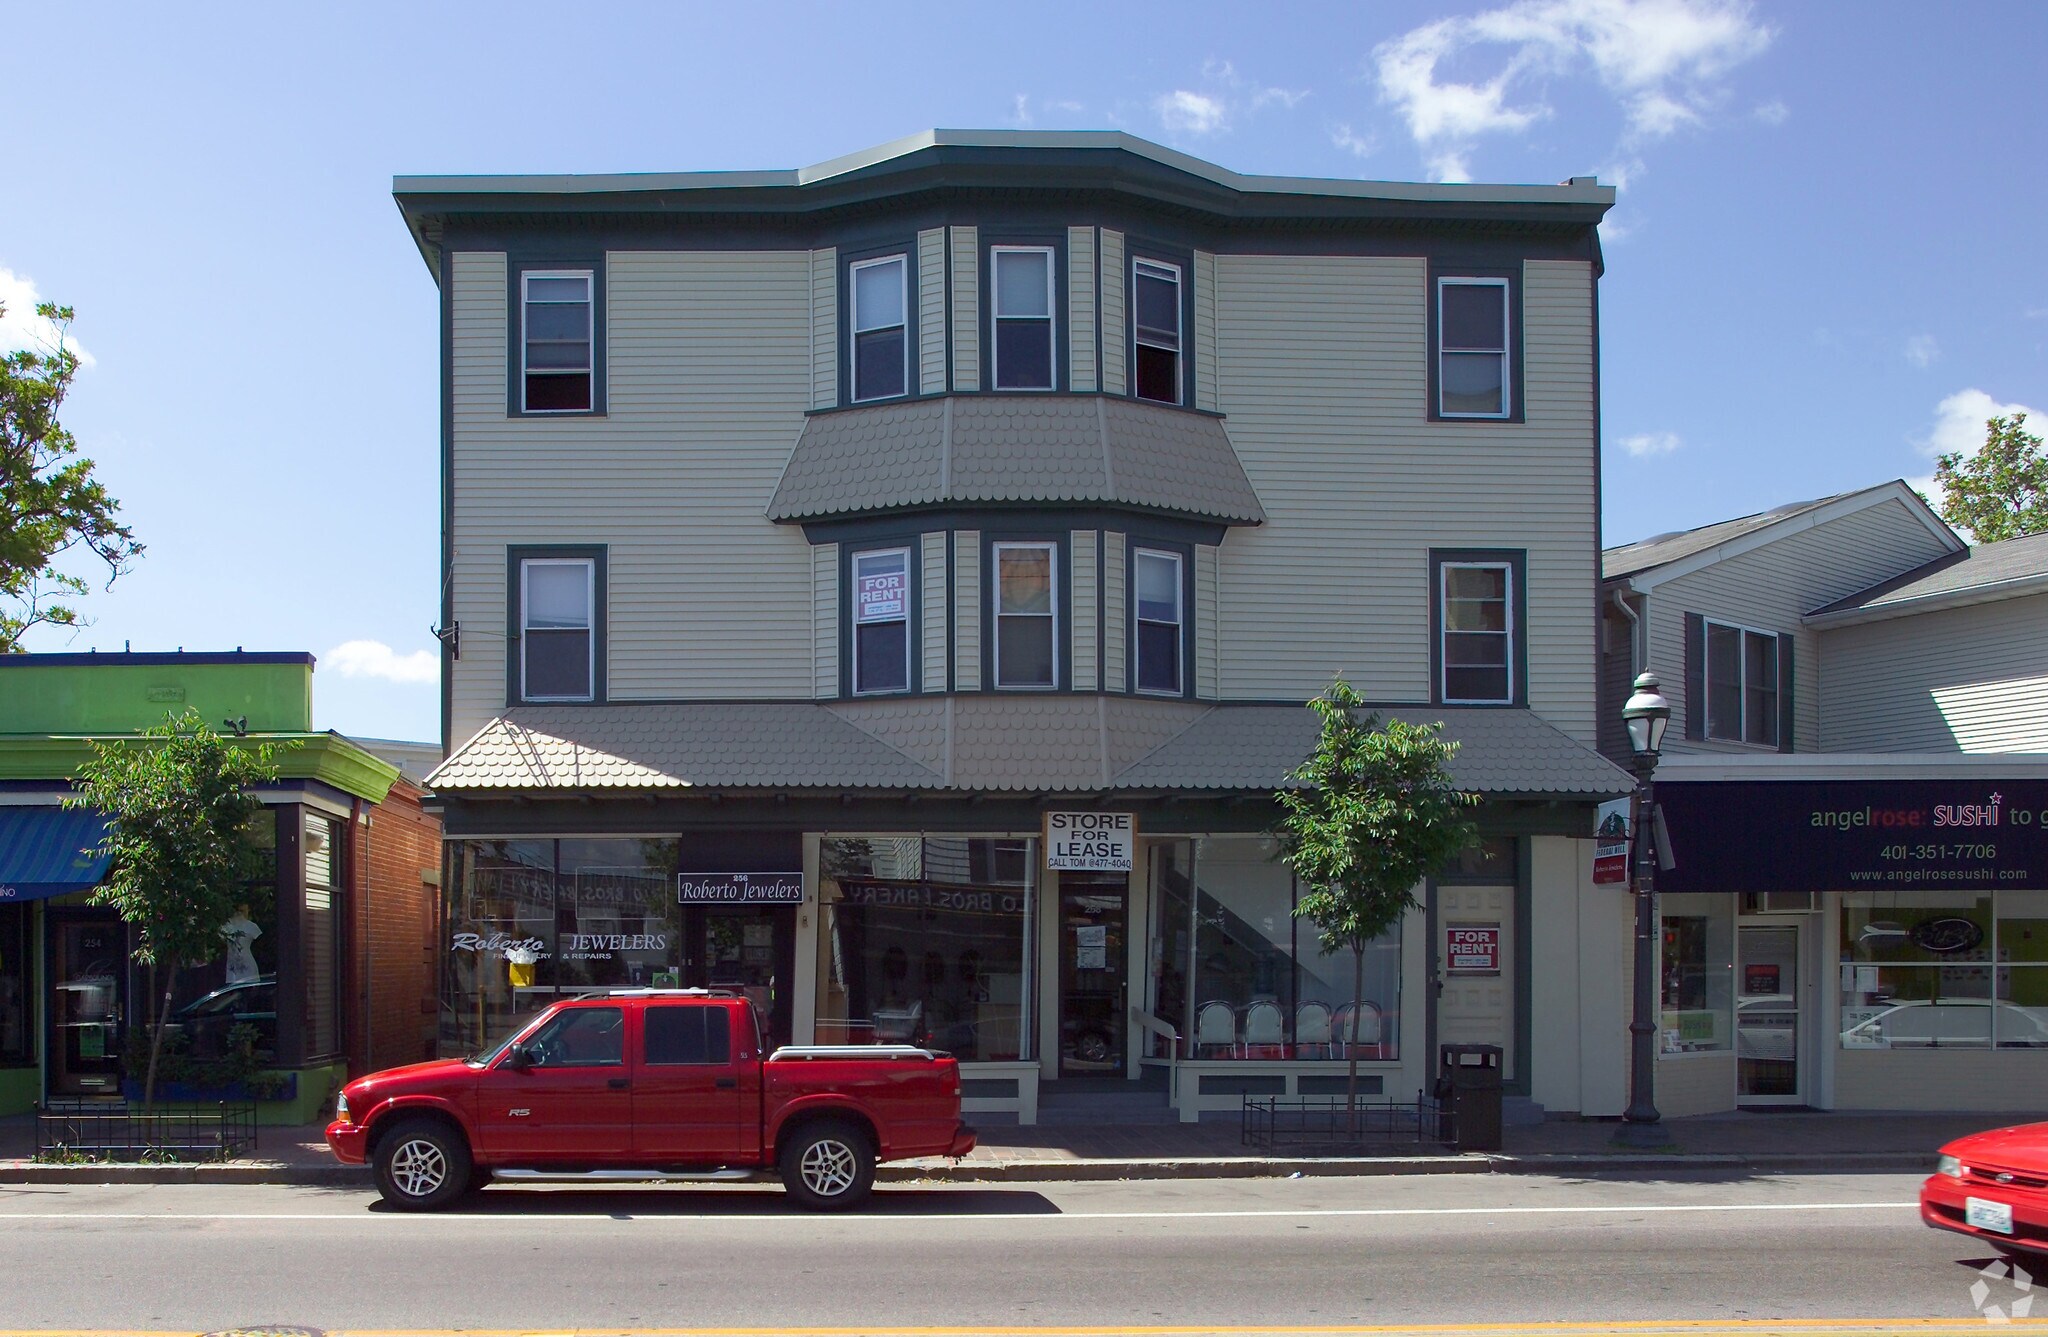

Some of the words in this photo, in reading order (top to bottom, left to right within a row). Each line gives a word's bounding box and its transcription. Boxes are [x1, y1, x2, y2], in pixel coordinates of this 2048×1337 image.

[865, 577, 899, 590] FOR
[860, 588, 904, 603] RENT
[1052, 813, 1129, 829] STORE
[2010, 808, 2032, 825] to
[1071, 831, 1109, 840] FOR
[1057, 842, 1123, 857] LEASE
[1881, 845, 1996, 860] 401-351-7706
[1048, 858, 1067, 868] CALL
[1070, 858, 1086, 867] TOM
[733, 874, 748, 882] 256
[1850, 868, 2027, 882] www.angelrosesushi.com
[681, 879, 737, 899] Roberto
[740, 879, 800, 901] Jewelers
[1085, 905, 1101, 914] 258
[451, 932, 544, 952] Roberto
[570, 934, 666, 950] JEWELERS
[1455, 931, 1490, 943] FOR
[85, 939, 101, 948] 254
[1450, 943, 1496, 954] RENT
[493, 952, 512, 960] FIN
[508, 1108, 531, 1117] RS
